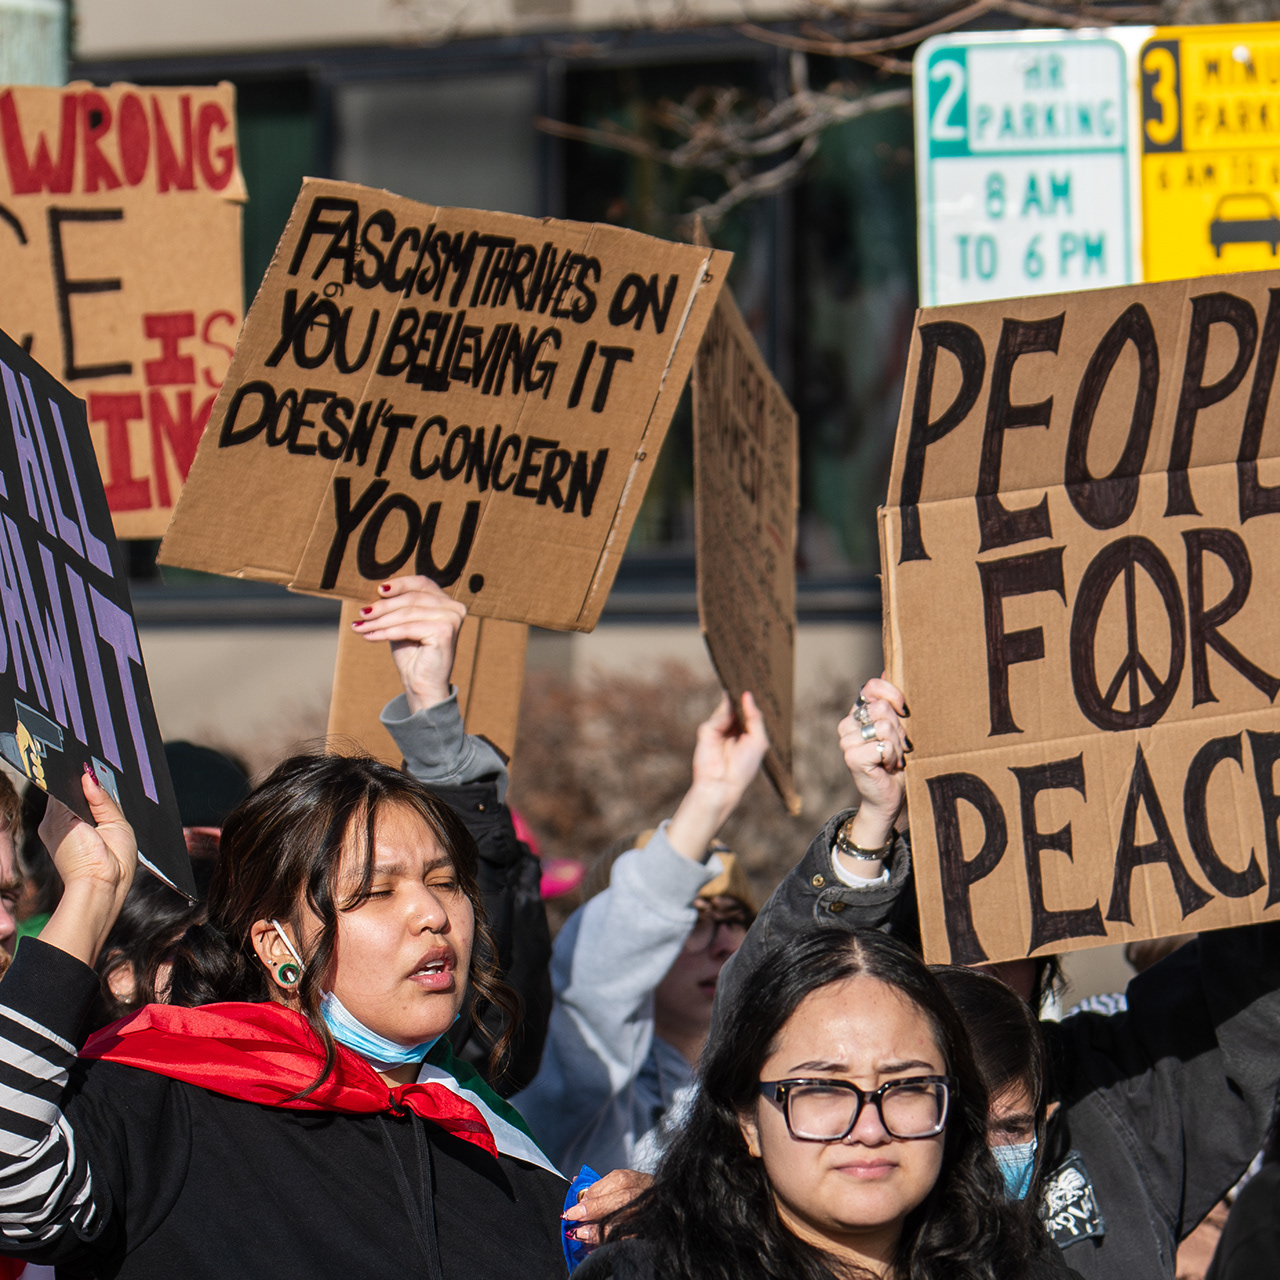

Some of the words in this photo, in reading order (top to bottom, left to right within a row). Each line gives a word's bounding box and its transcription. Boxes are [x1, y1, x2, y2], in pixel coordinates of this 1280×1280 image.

[931, 59, 966, 141] 2
[1024, 55, 1065, 91] HR
[1143, 47, 1179, 145] 3
[975, 101, 1117, 142] PARKING
[986, 173, 1005, 218] 8
[1021, 171, 1073, 217] AM
[1182, 161, 1217, 189] AM
[1231, 159, 1257, 188] TO
[288, 195, 476, 309] FASCISM
[468, 233, 602, 323] THRIVES
[608, 271, 679, 334] ON
[955, 234, 998, 280] TO
[1024, 234, 1044, 279] 6
[1060, 232, 1107, 278] PM
[141, 308, 237, 391] IS
[266, 289, 380, 375] YOU
[377, 308, 561, 400] BELIEVING
[567, 339, 634, 413] IT
[219, 379, 416, 478] DOESN'T
[410, 415, 609, 517] CONCERN
[320, 476, 485, 594] YOU.
[66, 567, 160, 805] IT
